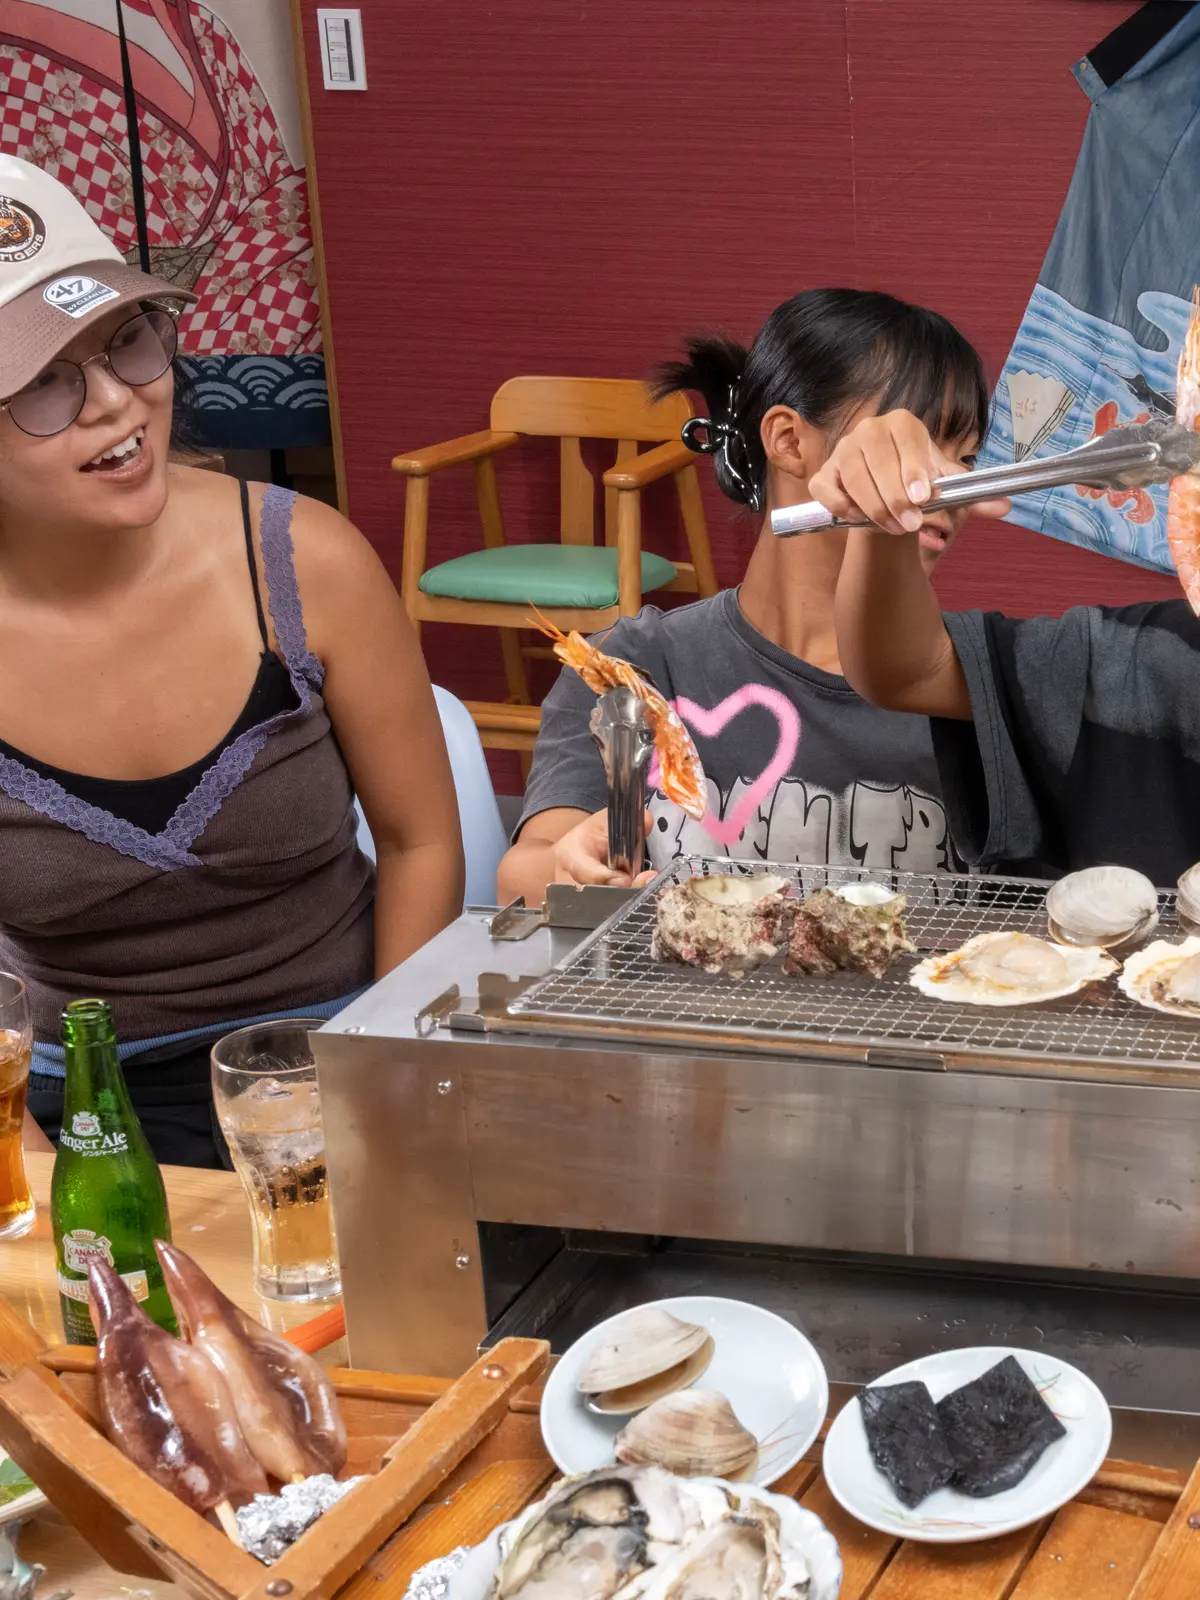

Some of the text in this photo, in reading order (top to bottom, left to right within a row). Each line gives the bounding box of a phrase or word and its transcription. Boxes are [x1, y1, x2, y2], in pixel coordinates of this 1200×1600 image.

[0, 234, 44, 260] TIGERS
[60, 1129, 127, 1152] Ginger Ale
[68, 1247, 105, 1257] CANADA
